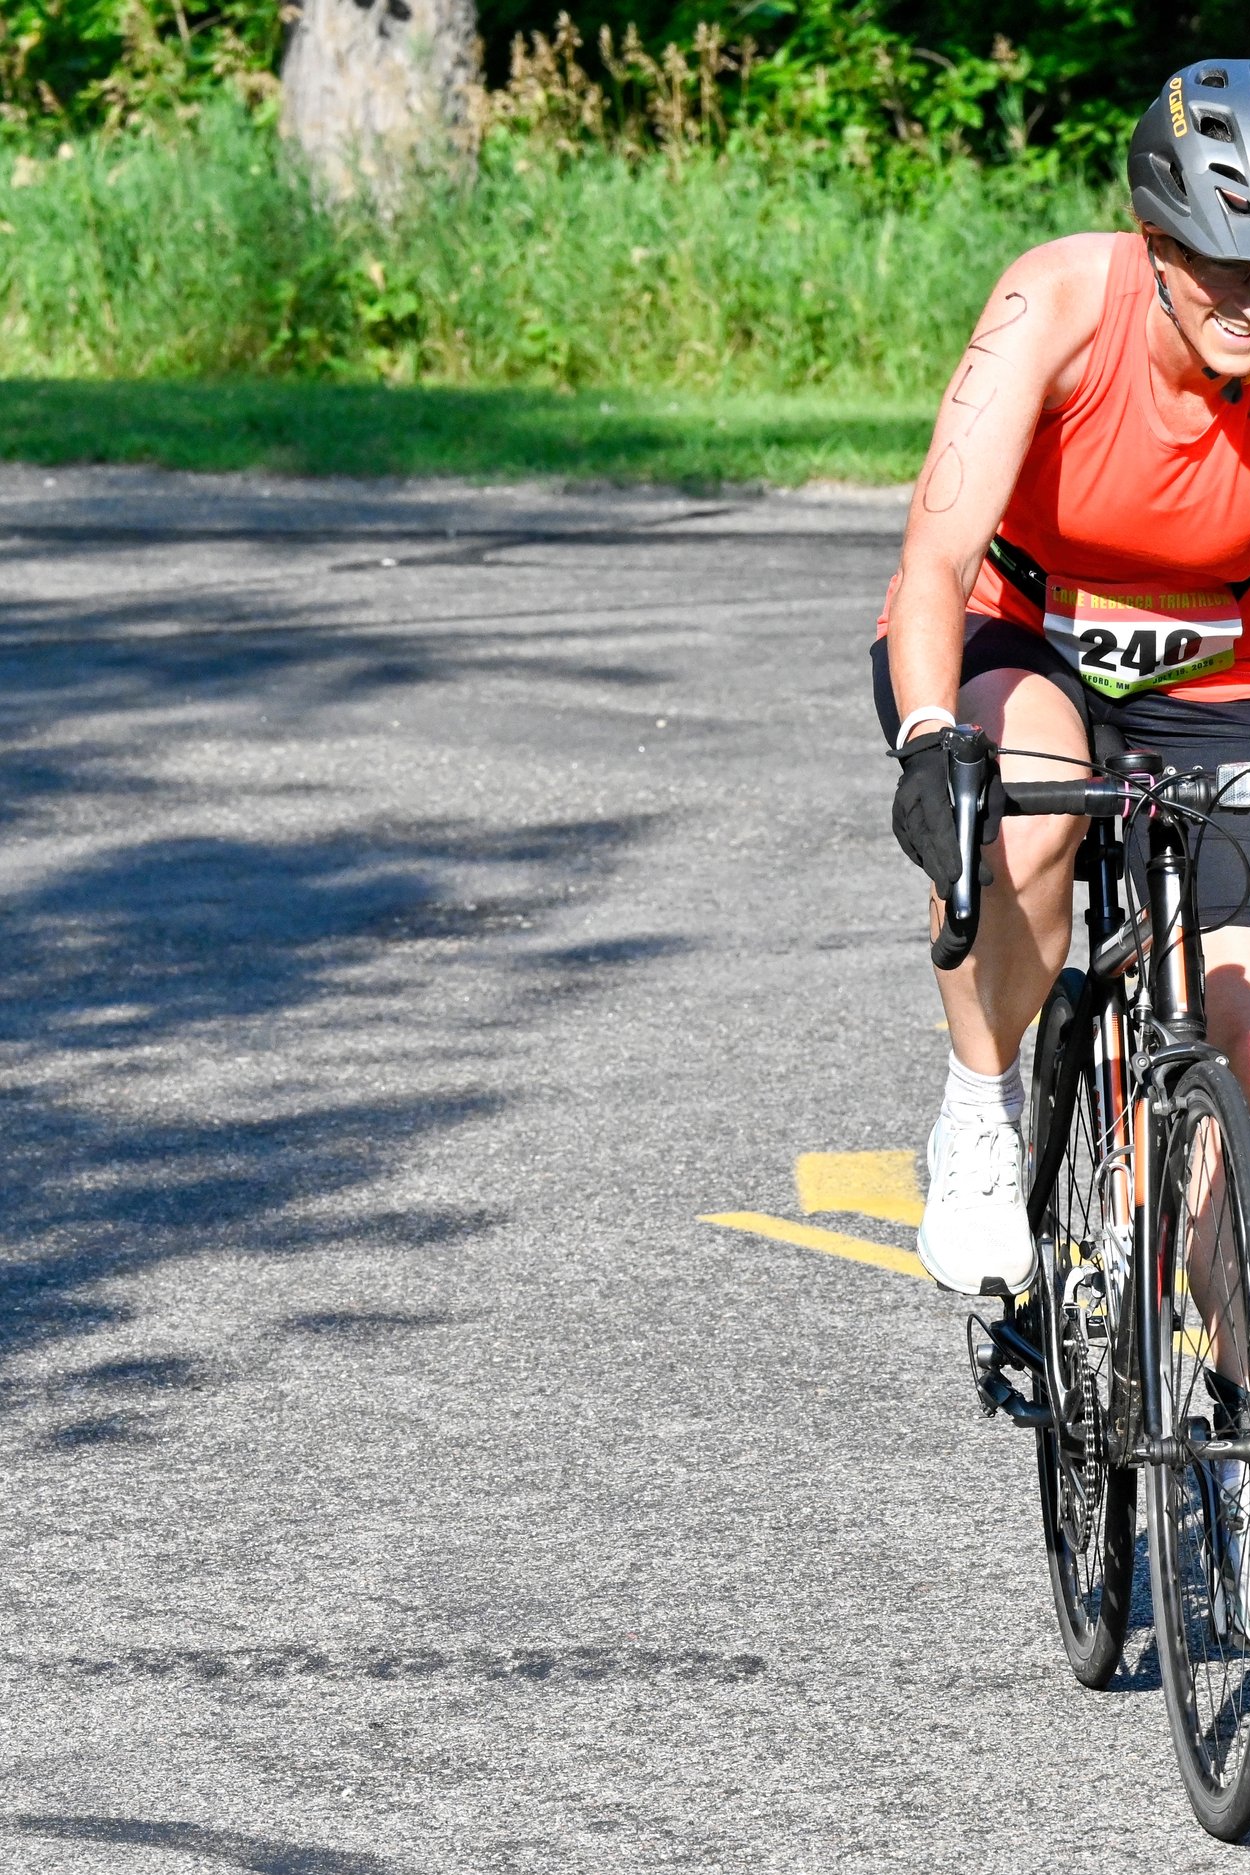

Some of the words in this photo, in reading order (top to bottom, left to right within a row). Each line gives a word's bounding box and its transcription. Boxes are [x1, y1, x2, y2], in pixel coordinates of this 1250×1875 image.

[1168, 91, 1188, 138] GIRO
[922, 292, 1028, 513] 240
[1091, 593, 1153, 610] REBECCA
[1079, 628, 1202, 677] 240
[1115, 681, 1130, 690] MN
[1152, 671, 1173, 684] JULY
